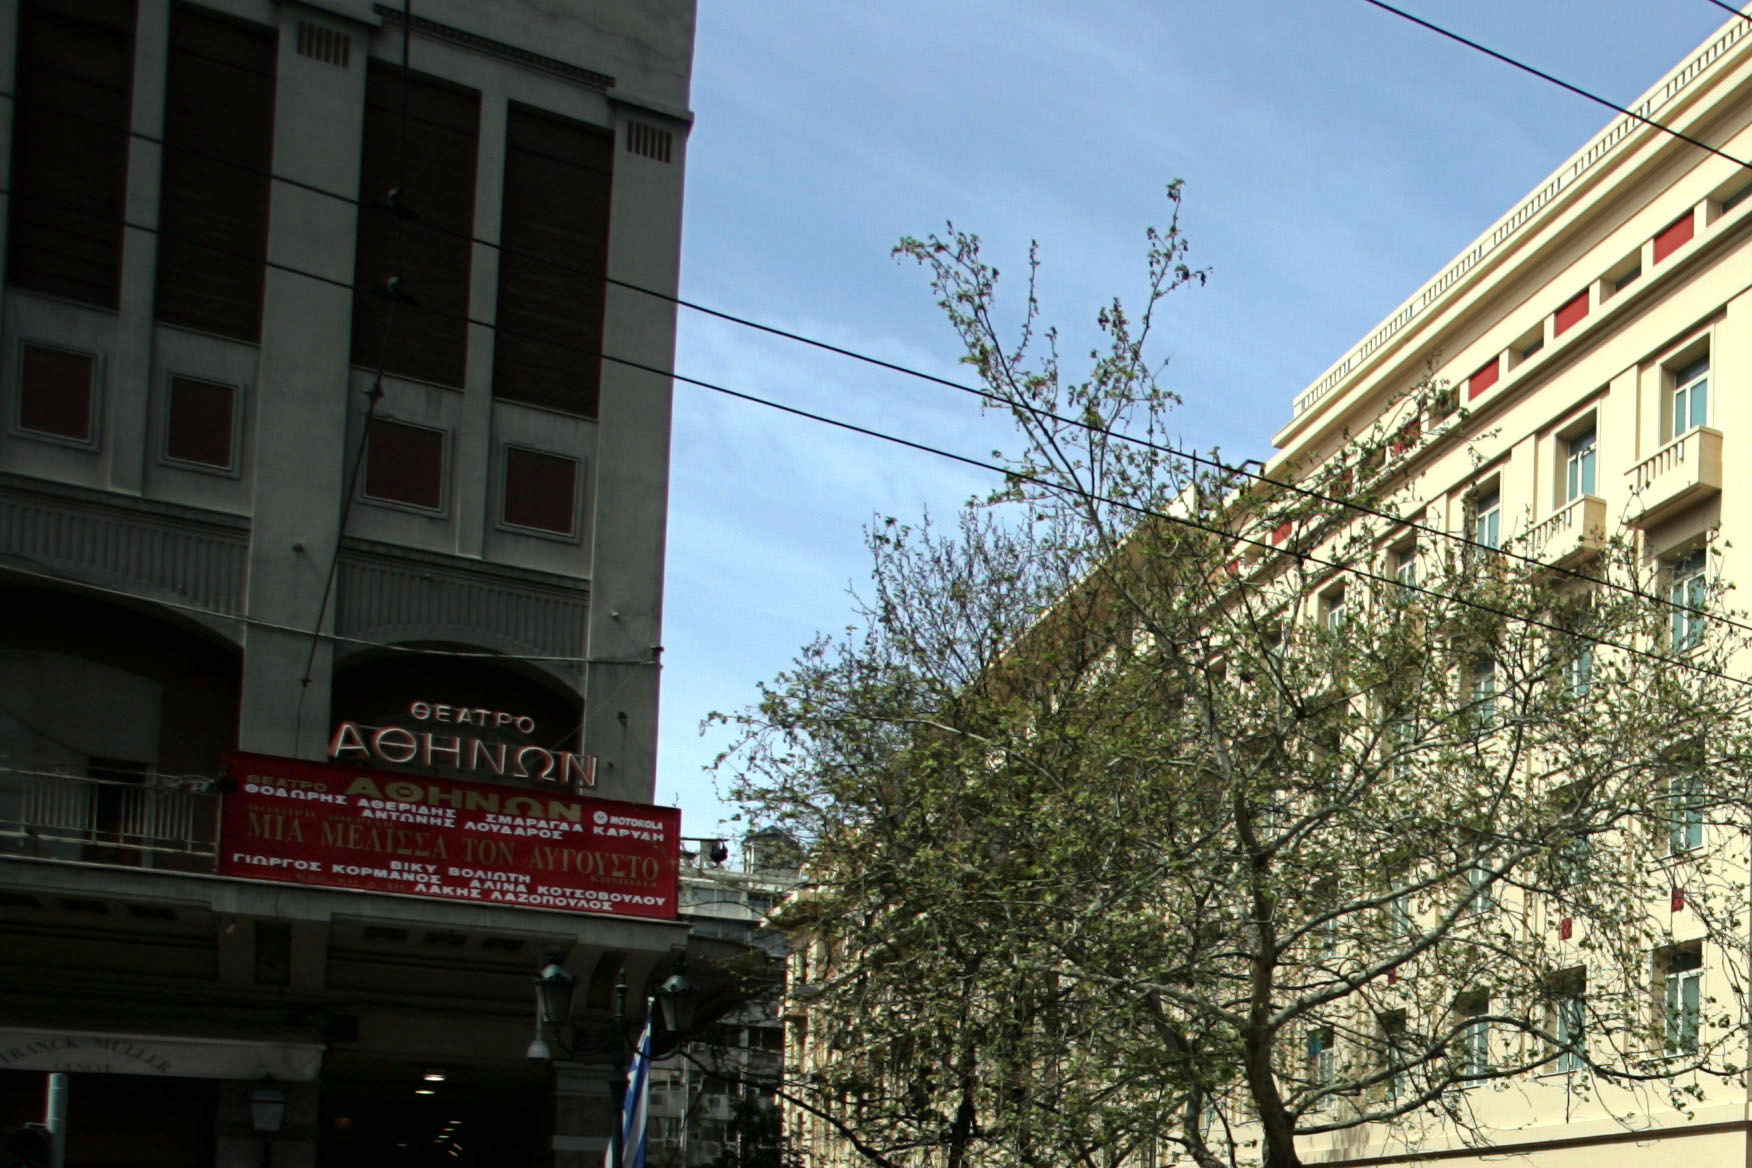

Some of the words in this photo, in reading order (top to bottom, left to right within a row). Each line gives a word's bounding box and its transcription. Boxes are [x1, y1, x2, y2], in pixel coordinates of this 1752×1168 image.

[408, 699, 537, 734] ΘΕΑΤΡΟ
[329, 720, 598, 788] ΑΘΗΝΩΝ
[243, 783, 348, 806] ΘΟΔΩΡΗΣ
[357, 798, 457, 819] ΑΘΕΡΙΔΗΣ
[244, 773, 329, 793] ΘΕΑΤΡΟ
[344, 776, 583, 823] ΑΘΗΝΩΝ
[360, 808, 456, 829] ΑΝΤΩΝΗΣ
[464, 820, 565, 840] ΛΟΥΔΑΡΟΣ
[485, 813, 584, 833] ΣΜΑΡΑΓΔΑ
[592, 825, 665, 843] ΚΑΡΥΔΗ
[608, 815, 664, 831] MOTOROLA
[246, 812, 305, 843] ΜΙΑ
[319, 821, 450, 861] ΜΕΛΙΣΣΑ
[462, 837, 517, 866] ΤΟΝ
[528, 844, 660, 882] ΑΥΓΟΥΣΤΟ
[232, 852, 322, 872] ΓΙΩΡΓΟΣ
[332, 863, 442, 885] ΚΟΡΜΑΝΟΣ
[390, 860, 439, 874] ΒΙΚΥ
[448, 866, 532, 885] ΒΟΛΙΩΤΗ
[415, 884, 482, 899] ΛΑΚΗΣ
[490, 892, 614, 911] ΛΑΖΟΠΟΥΛΟΣ
[469, 879, 529, 893] ΑΛΙΝΑ
[537, 886, 666, 907] ΚΟΤΣΟΒΟΥΛΟΥ
